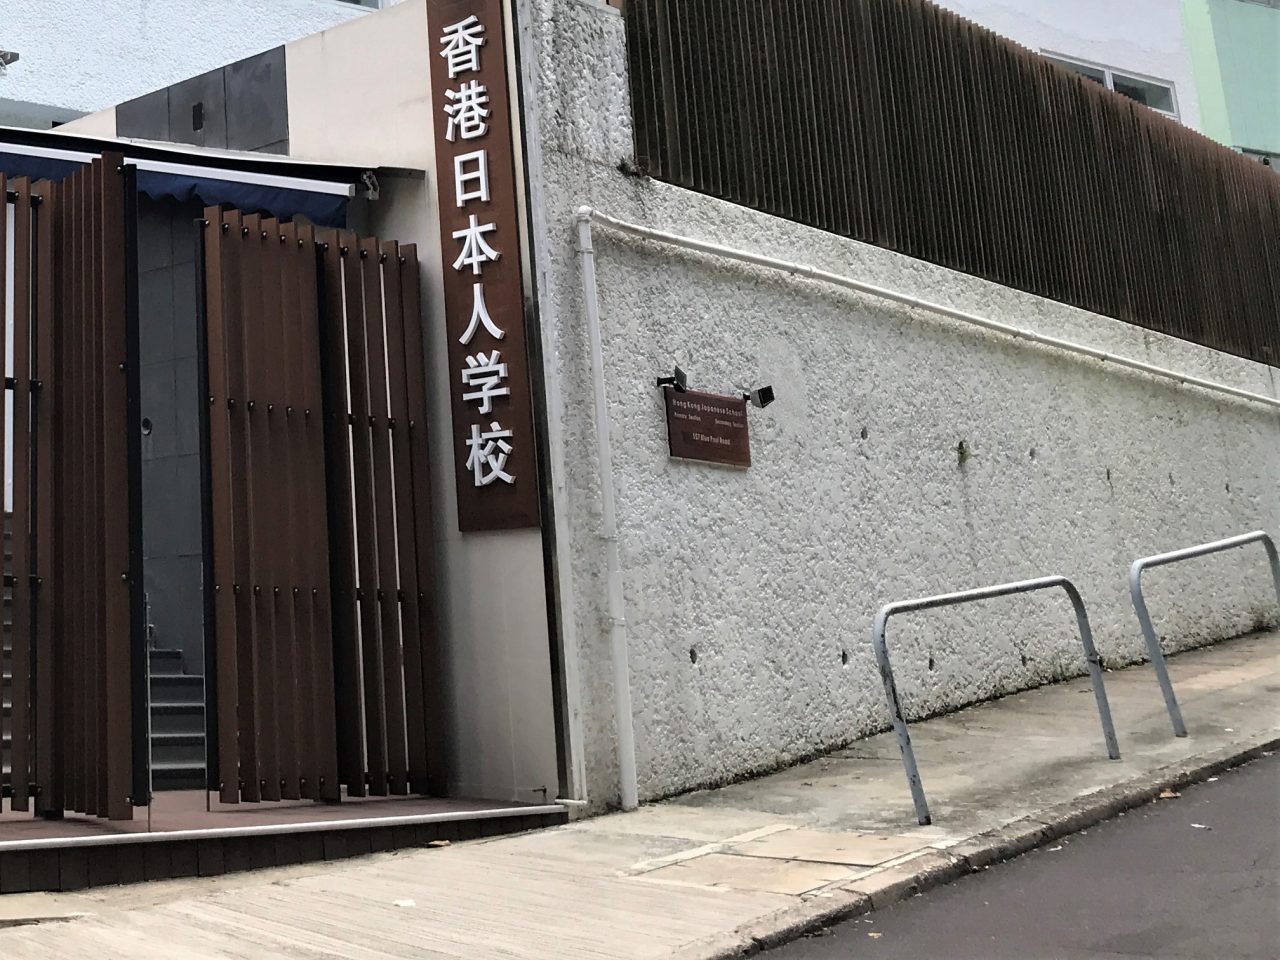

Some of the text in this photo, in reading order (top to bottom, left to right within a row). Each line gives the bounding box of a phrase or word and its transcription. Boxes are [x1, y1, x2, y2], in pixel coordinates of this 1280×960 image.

[439, 14, 517, 488] 香港日本人学校
[672, 398, 743, 417] Hong Kong Japanese School
